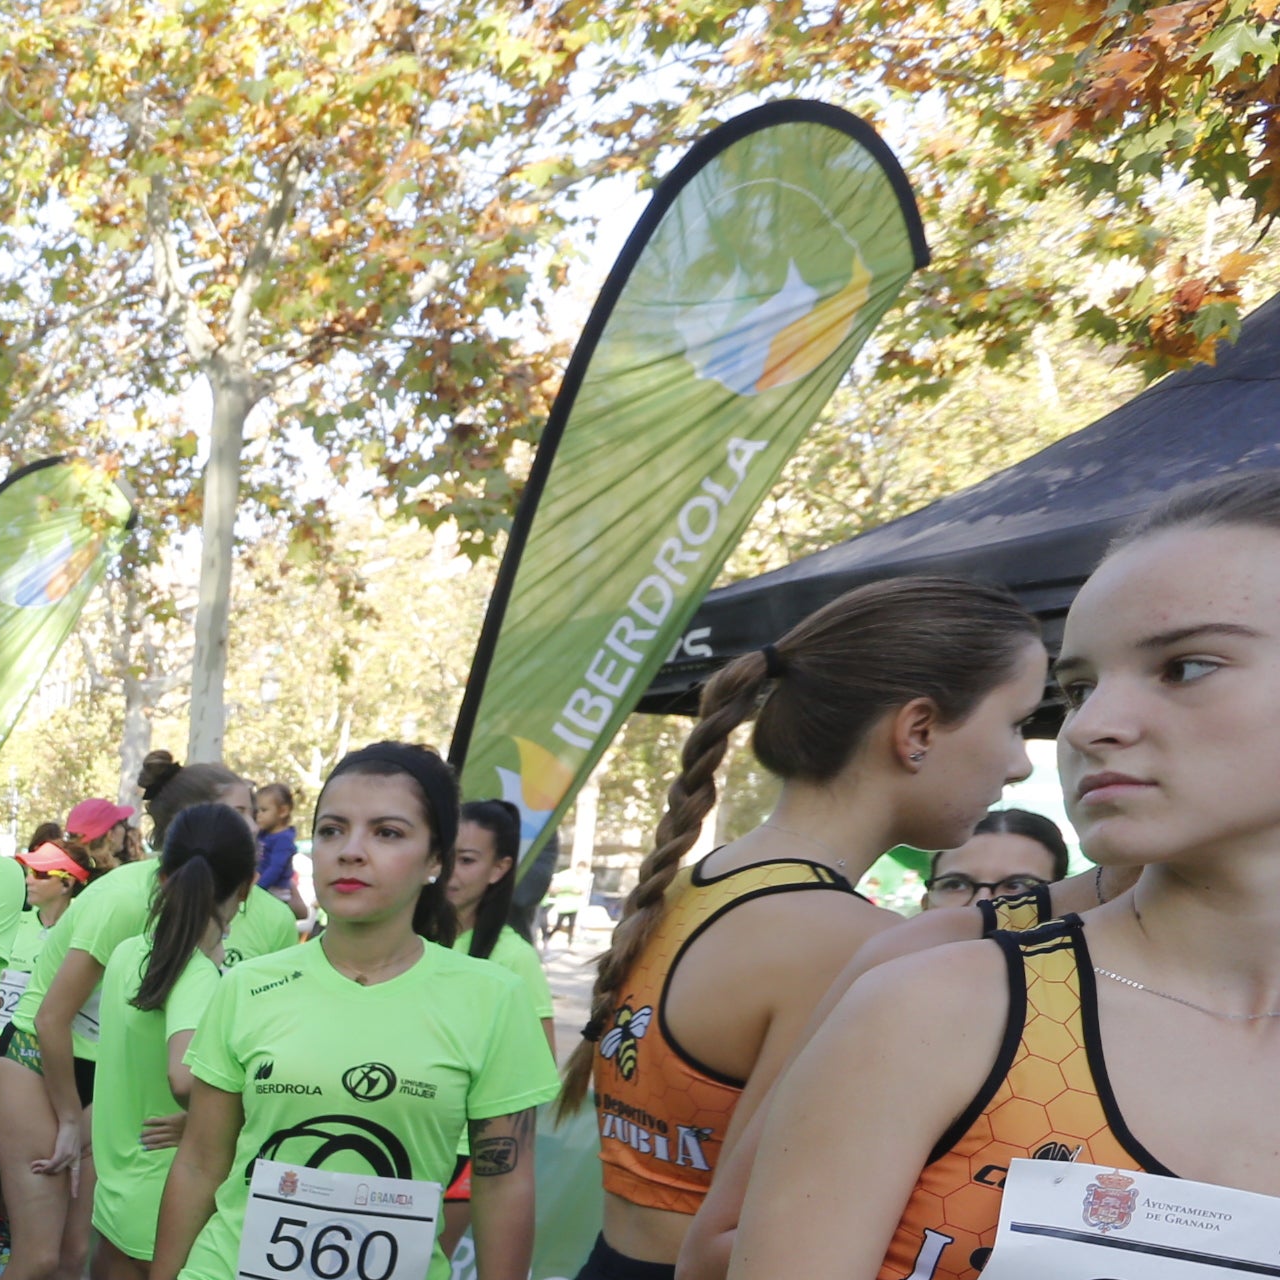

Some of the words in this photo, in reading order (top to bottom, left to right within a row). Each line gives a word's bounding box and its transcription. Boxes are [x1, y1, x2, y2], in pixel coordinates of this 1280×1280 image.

[552, 436, 768, 749] IBERDROLA
[250, 976, 290, 997] luanvi
[255, 1082, 323, 1096] IBERDROLA
[399, 1086, 437, 1100] MUJER
[601, 1112, 713, 1172] ZUBIA
[1142, 1197, 1233, 1222] AYUNTAMIENTO
[1145, 1212, 1163, 1222] DE
[1164, 1213, 1221, 1232] GRANADA
